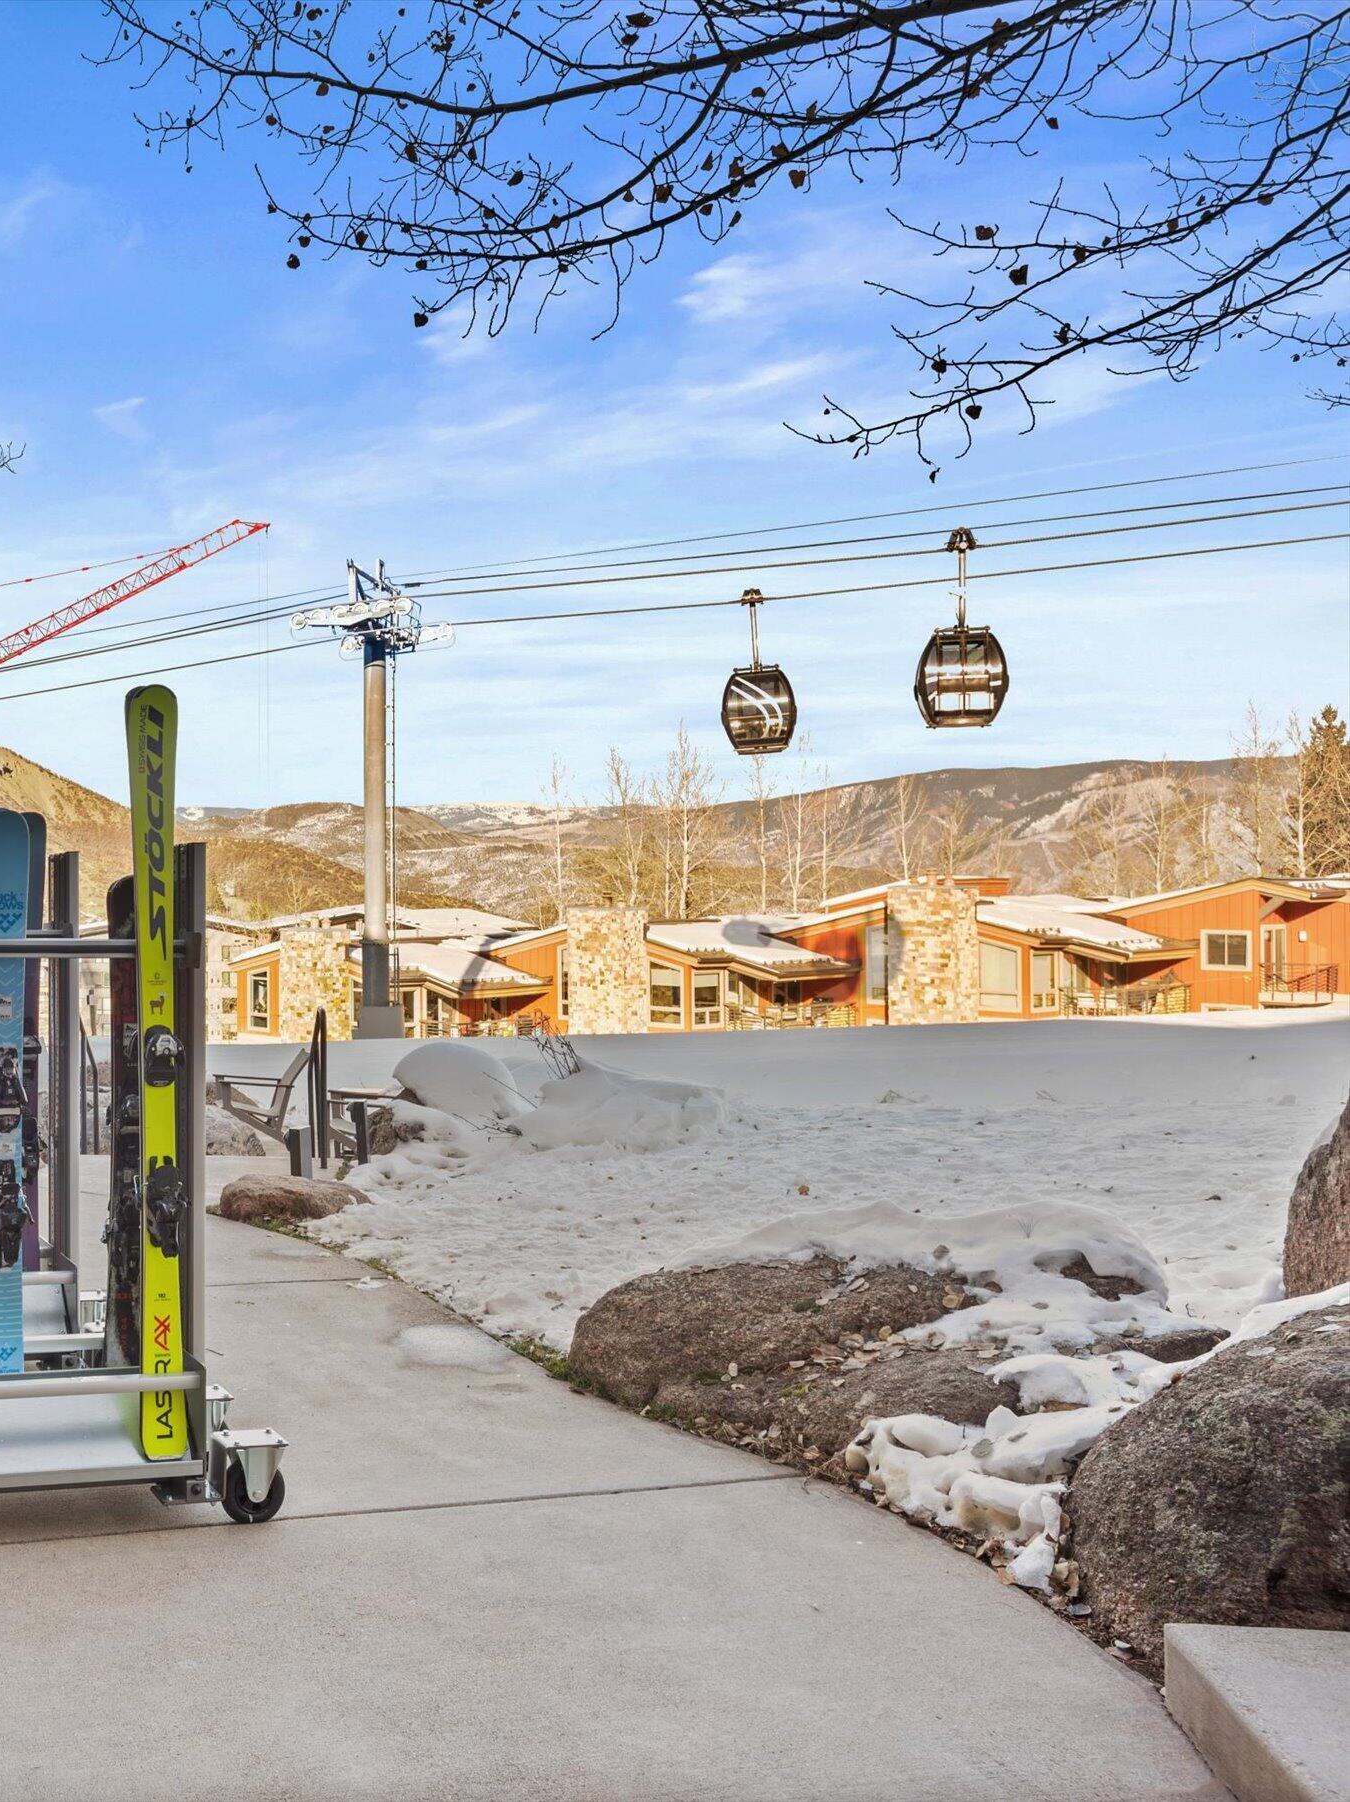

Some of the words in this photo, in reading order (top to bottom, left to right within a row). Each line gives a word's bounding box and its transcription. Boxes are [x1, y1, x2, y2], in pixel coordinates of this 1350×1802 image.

[140, 704, 148, 733] MADE
[144, 704, 166, 960] STÖCKLI
[154, 1314, 170, 1351] AX
[155, 1359, 173, 1440] LASR
